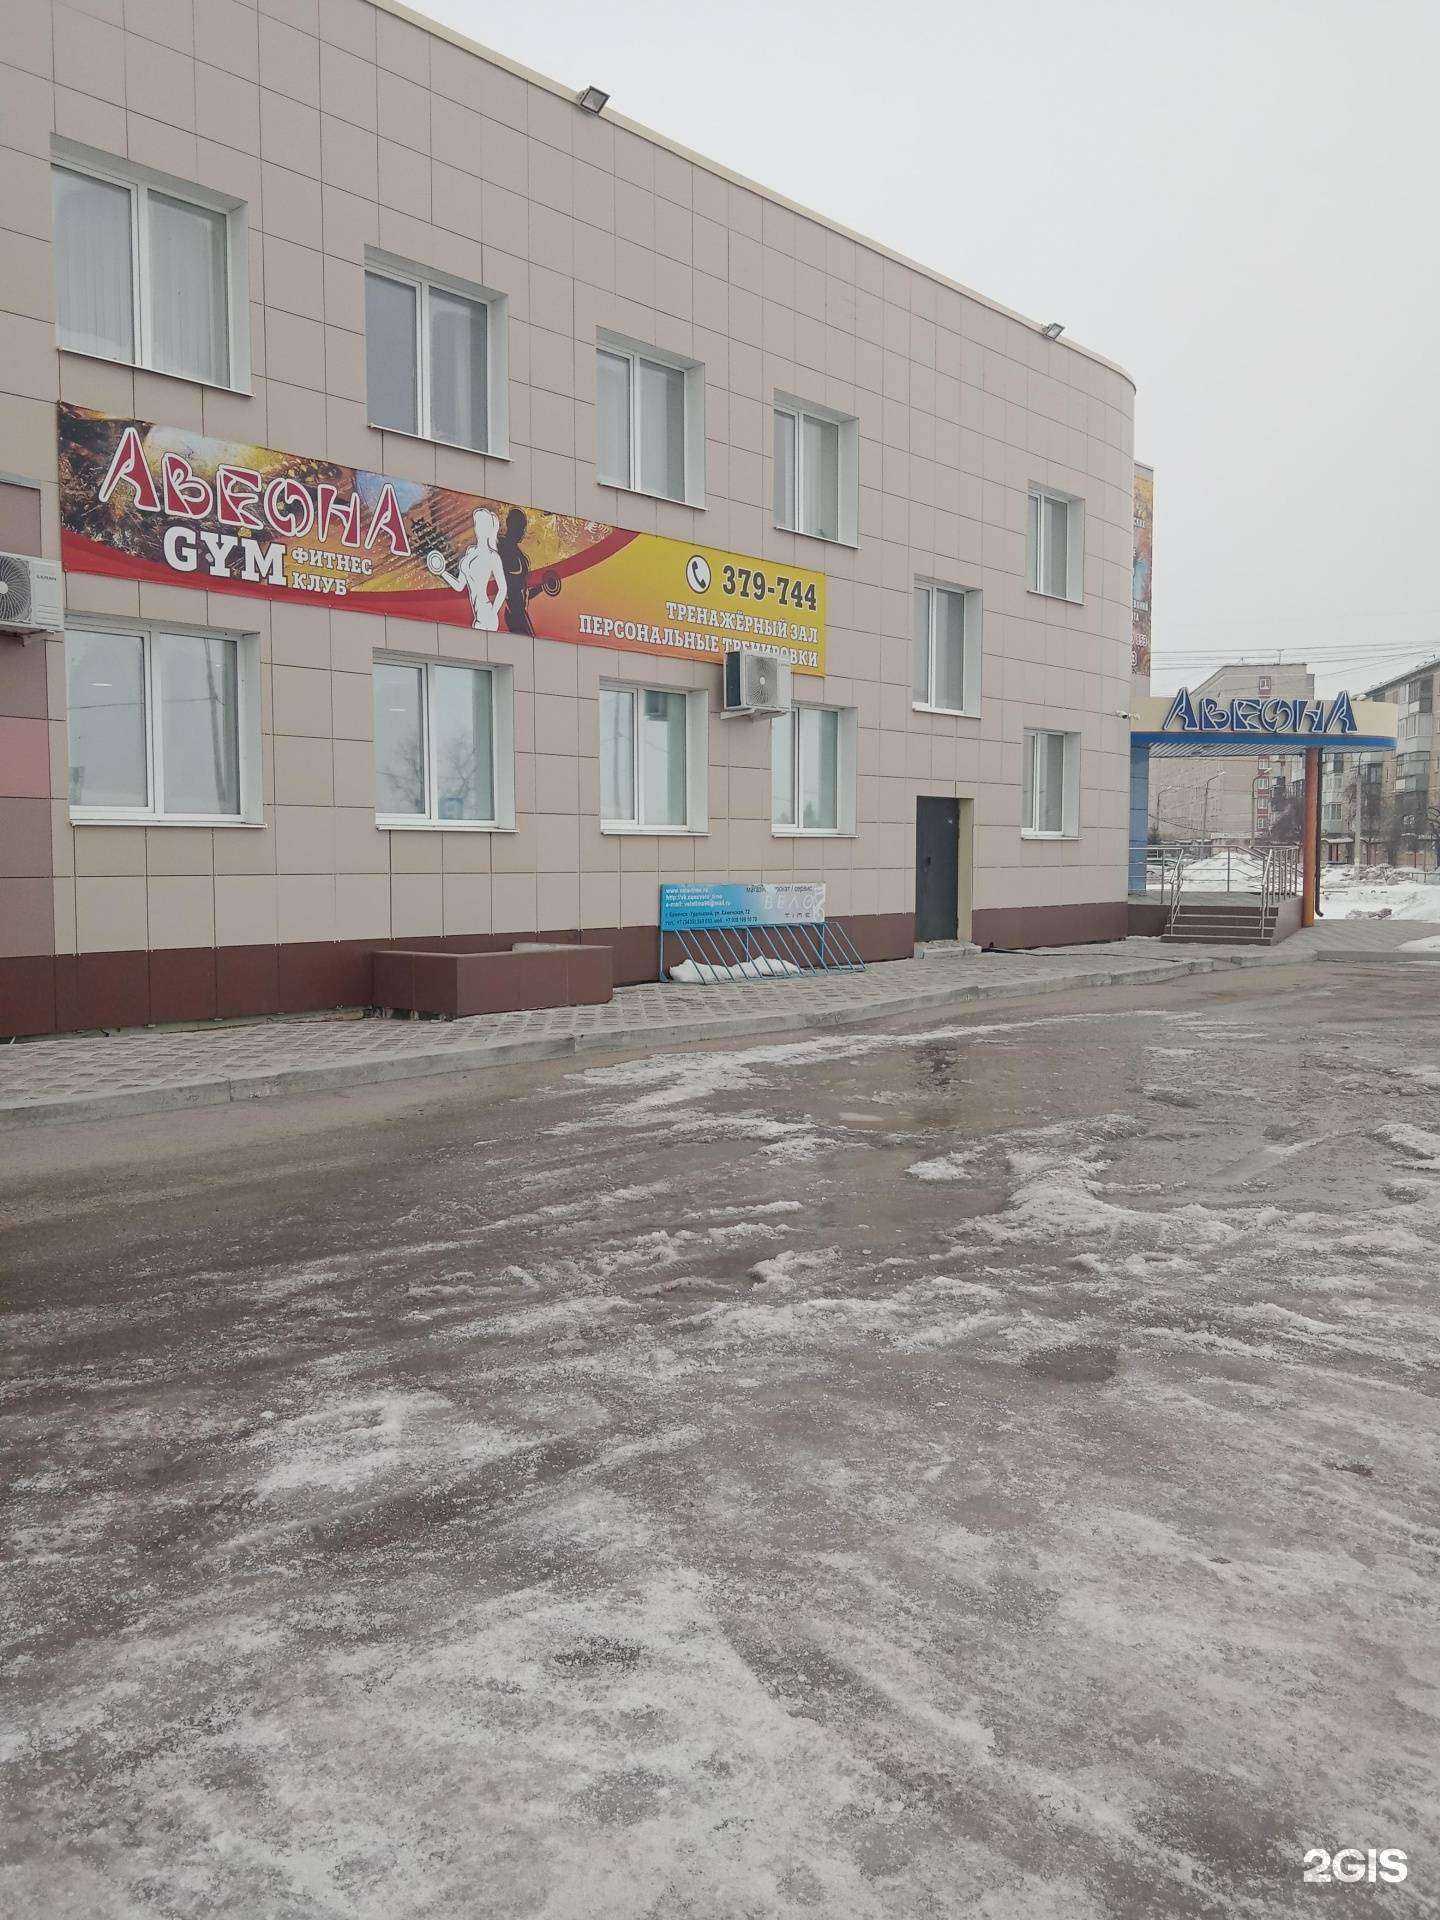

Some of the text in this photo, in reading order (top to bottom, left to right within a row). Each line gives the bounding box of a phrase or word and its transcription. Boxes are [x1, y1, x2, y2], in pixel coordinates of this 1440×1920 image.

[98, 427, 412, 557] АВЕОНА
[163, 526, 288, 587] GYM
[291, 546, 374, 576] ФИТНЕС
[291, 572, 349, 596] КЛУБ
[722, 564, 818, 612] 379-744
[578, 614, 720, 653] ПЕРСОНАЛЬНЫЕ
[665, 601, 818, 643] ТРЕНАЖЁРНЫЙ ЗАЛ
[1162, 686, 1358, 734] АВЕОНА
